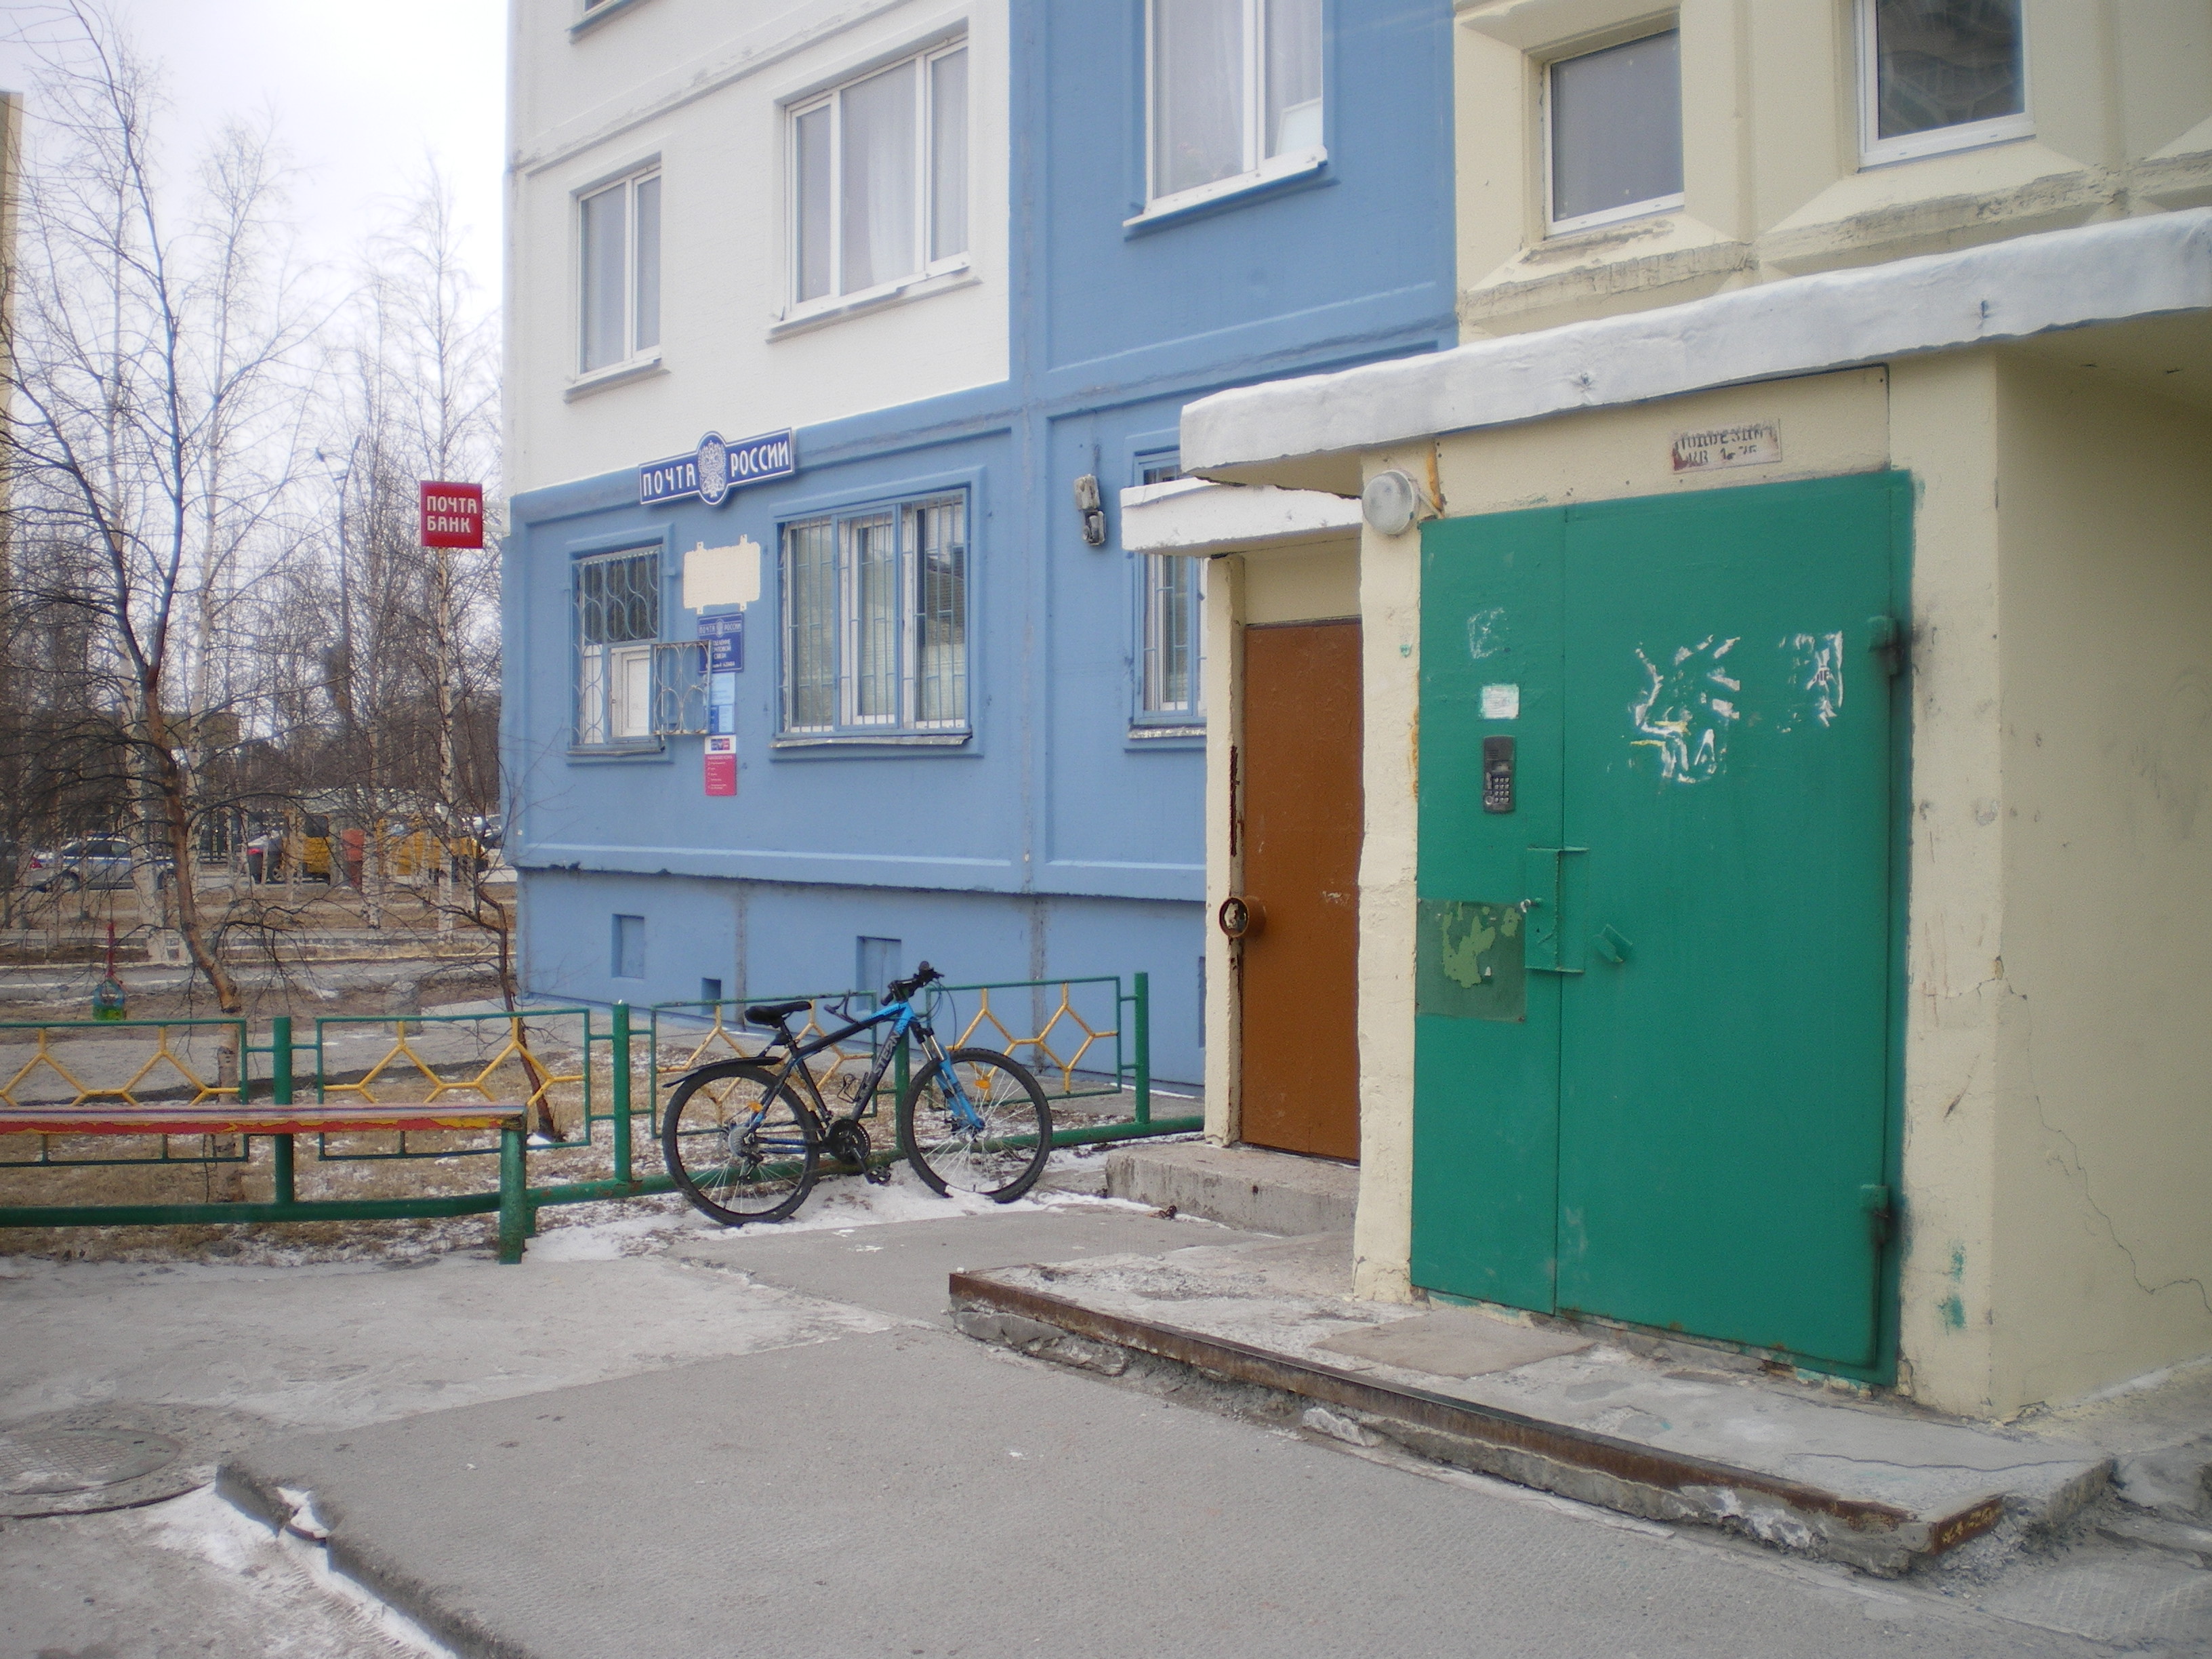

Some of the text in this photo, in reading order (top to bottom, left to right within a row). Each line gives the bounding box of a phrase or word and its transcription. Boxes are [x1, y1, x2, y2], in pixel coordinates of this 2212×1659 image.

[643, 441, 789, 496] ПОЧТА РОССИИ
[426, 495, 477, 514] ПОЧТА
[427, 515, 471, 533] БАНК
[699, 623, 741, 635] ПОЧТА РОССИИ
[874, 1031, 900, 1077] STERN
